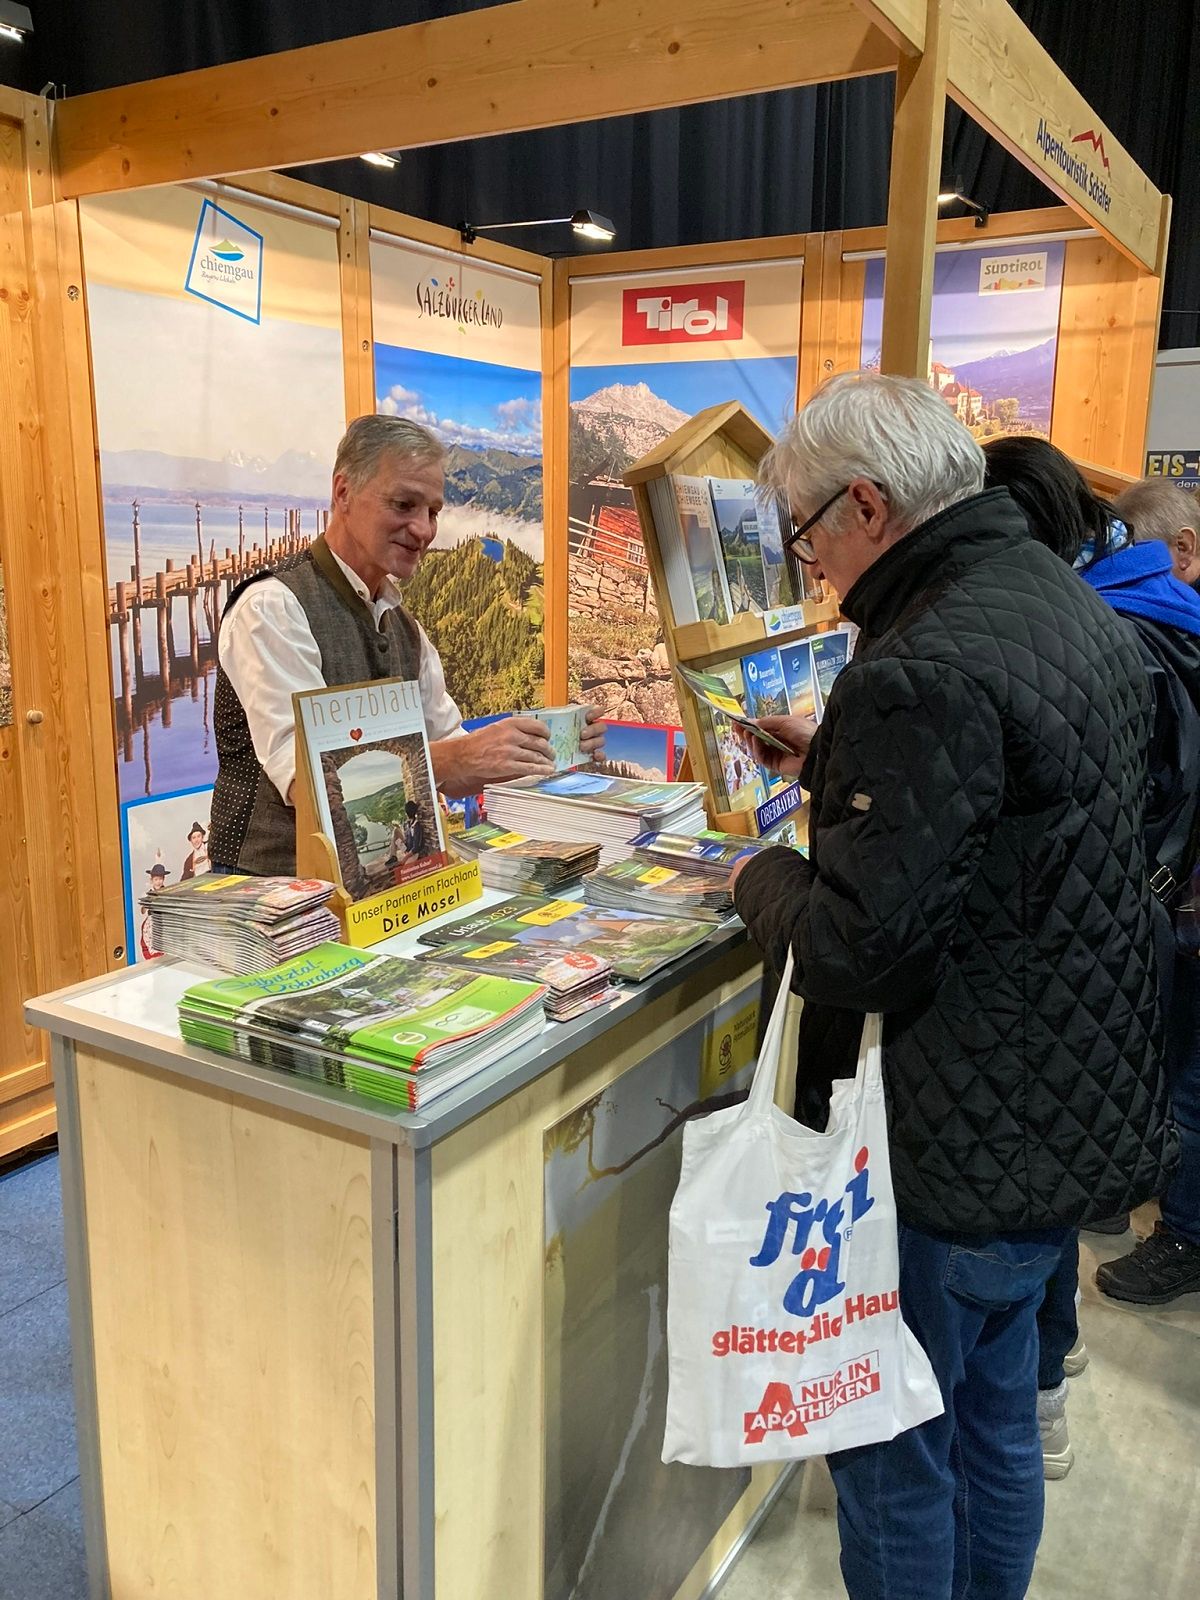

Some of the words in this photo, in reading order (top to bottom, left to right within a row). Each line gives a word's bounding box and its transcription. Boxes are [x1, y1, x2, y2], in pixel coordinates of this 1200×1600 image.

[1036, 118, 1089, 194] Alpentouristik
[1088, 171, 1112, 214] Schäfer
[200, 256, 254, 281] chiemgau
[636, 295, 729, 336] Tirol
[309, 681, 418, 727] herzblatt
[760, 786, 799, 828] OBERBAYERN
[352, 903, 384, 924] Unser
[386, 887, 422, 911] Partner
[423, 884, 435, 897] im
[437, 866, 478, 893] Flachland
[383, 912, 410, 933] Die
[418, 888, 460, 919] Mosel
[449, 917, 487, 937] Urlaub
[490, 905, 518, 921] 2023
[712, 1325, 807, 1357] glättet
[845, 1290, 900, 1325] Hau
[750, 1376, 872, 1430] APOTHEKEN
[802, 1370, 842, 1402] NUR
[848, 1359, 871, 1380] IN
